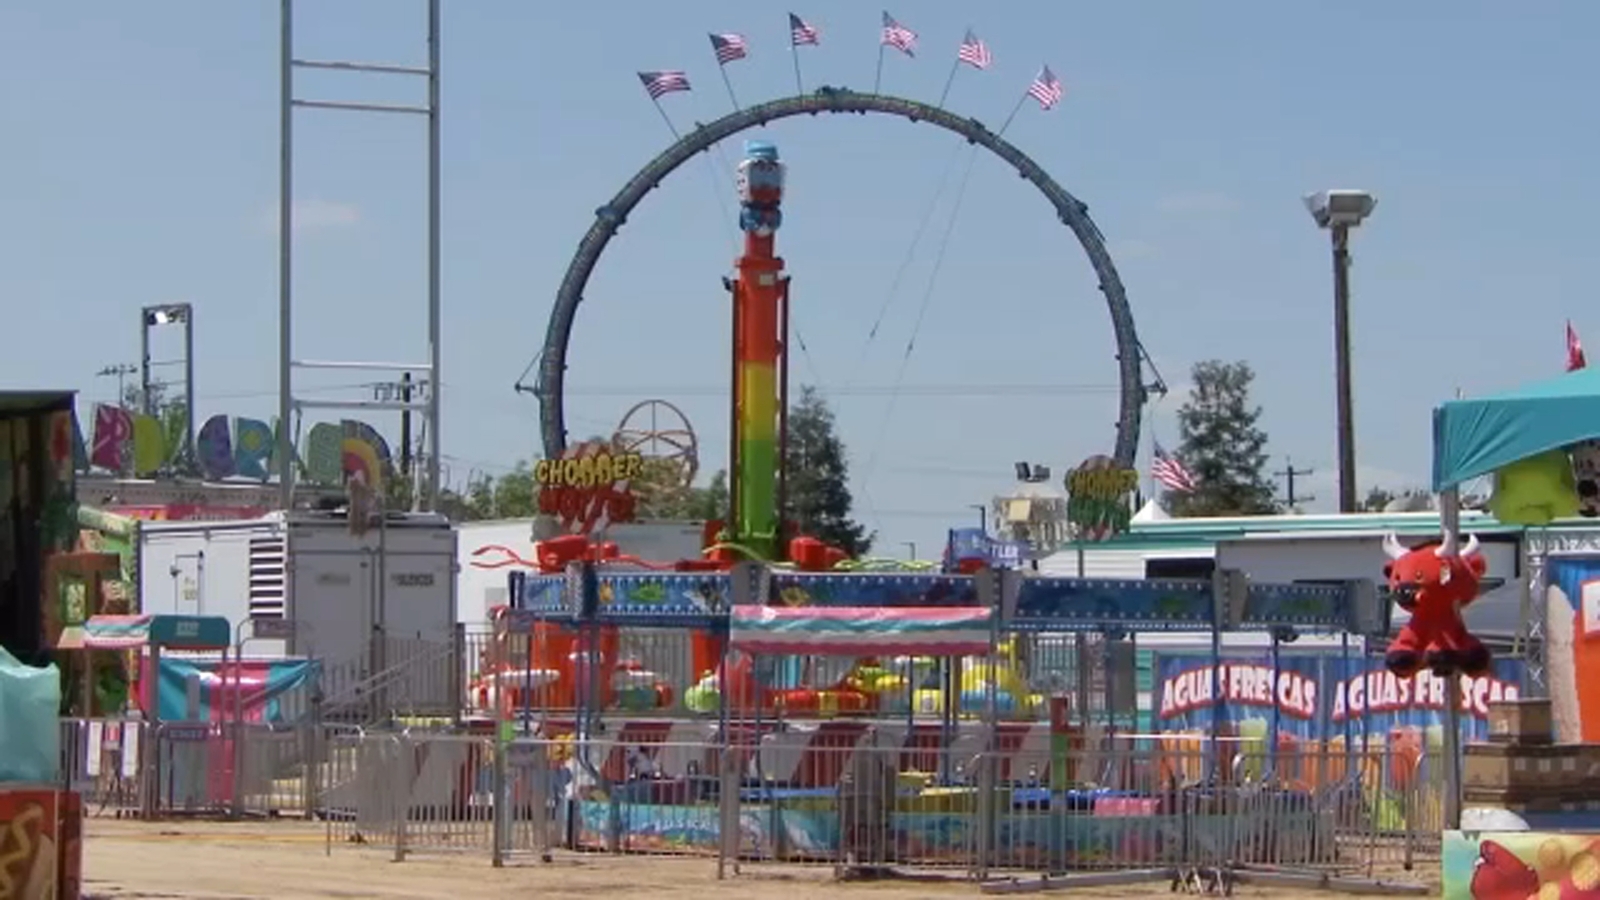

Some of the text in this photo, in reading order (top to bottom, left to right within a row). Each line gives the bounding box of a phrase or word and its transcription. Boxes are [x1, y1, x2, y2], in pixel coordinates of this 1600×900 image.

[1160, 665, 1227, 714] AGUAS
[1333, 668, 1519, 718] AGUAS FRSCA
